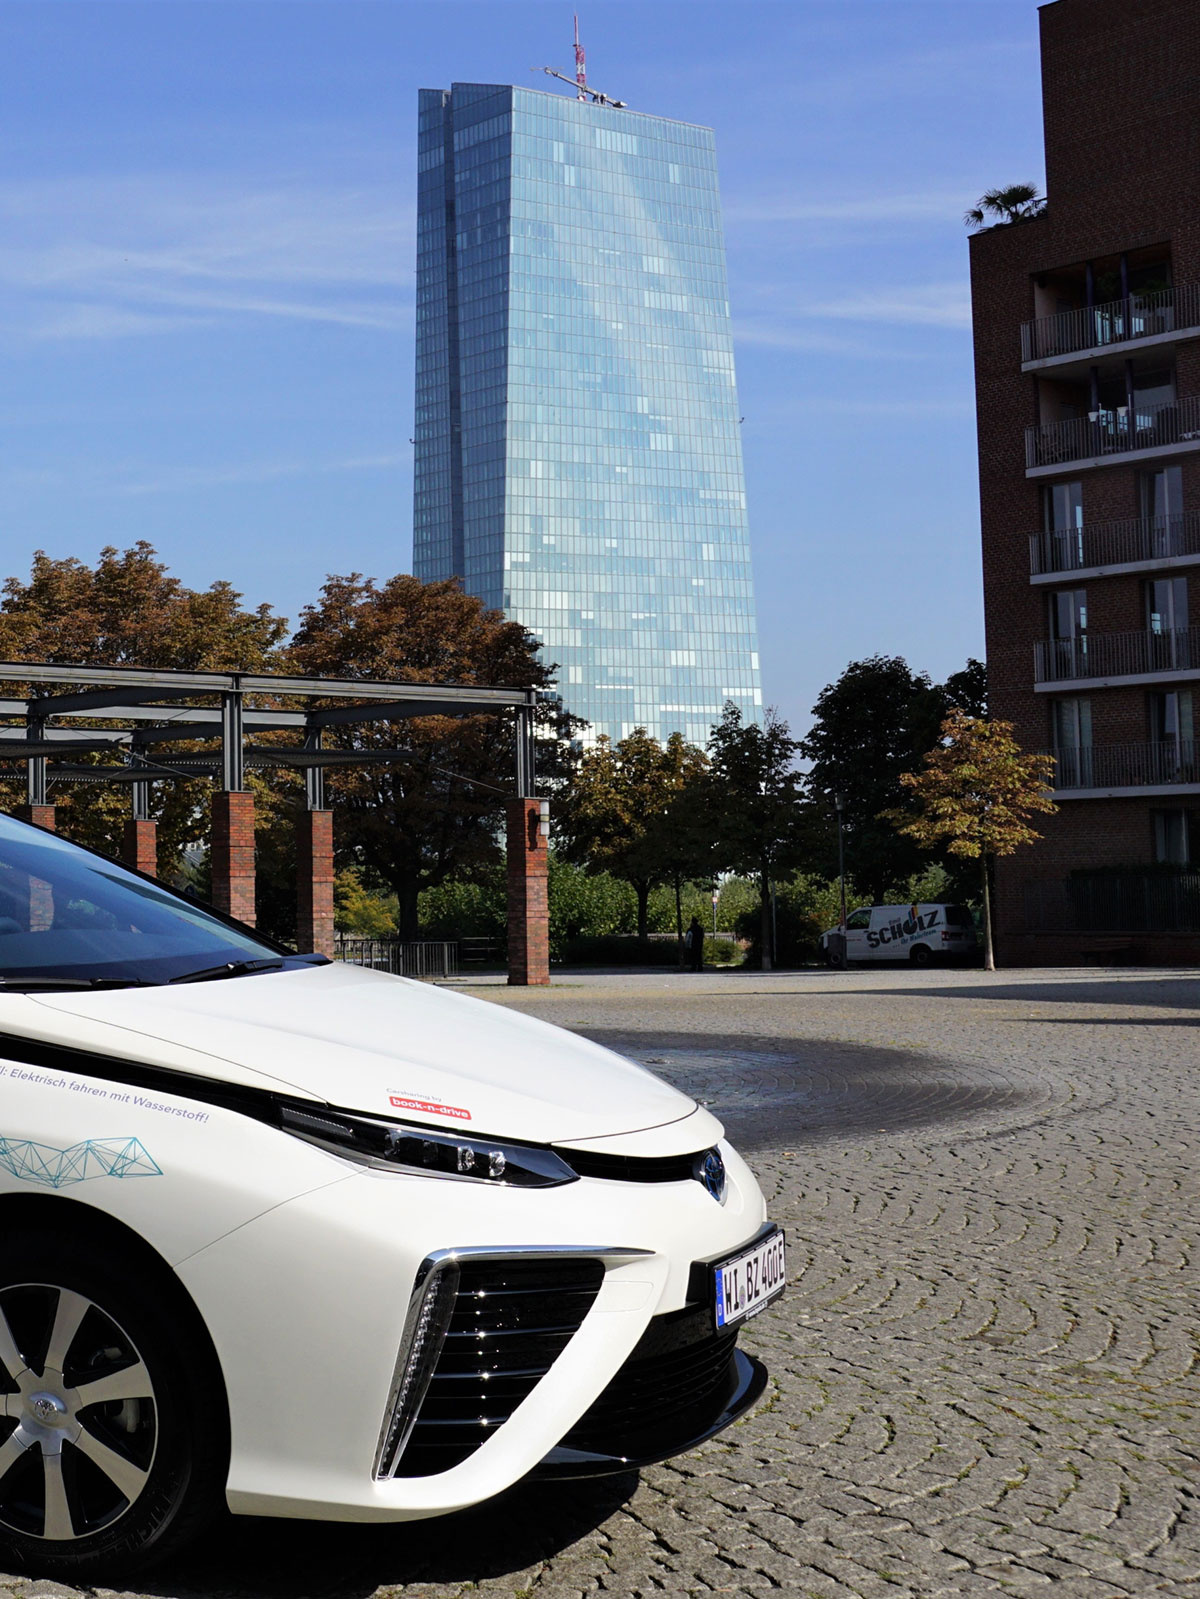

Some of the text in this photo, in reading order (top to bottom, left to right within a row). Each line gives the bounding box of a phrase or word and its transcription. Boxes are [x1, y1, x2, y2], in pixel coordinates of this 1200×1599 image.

[866, 910, 941, 948] SCHOLZ
[10, 1068, 67, 1088] Elektrisch
[68, 1081, 107, 1098] fahren
[110, 1092, 130, 1104] mit
[133, 1096, 210, 1124] Wasserstoff!
[392, 1098, 469, 1118] book-n-drive
[747, 1257, 760, 1302] BZ
[762, 1240, 784, 1291] 400E
